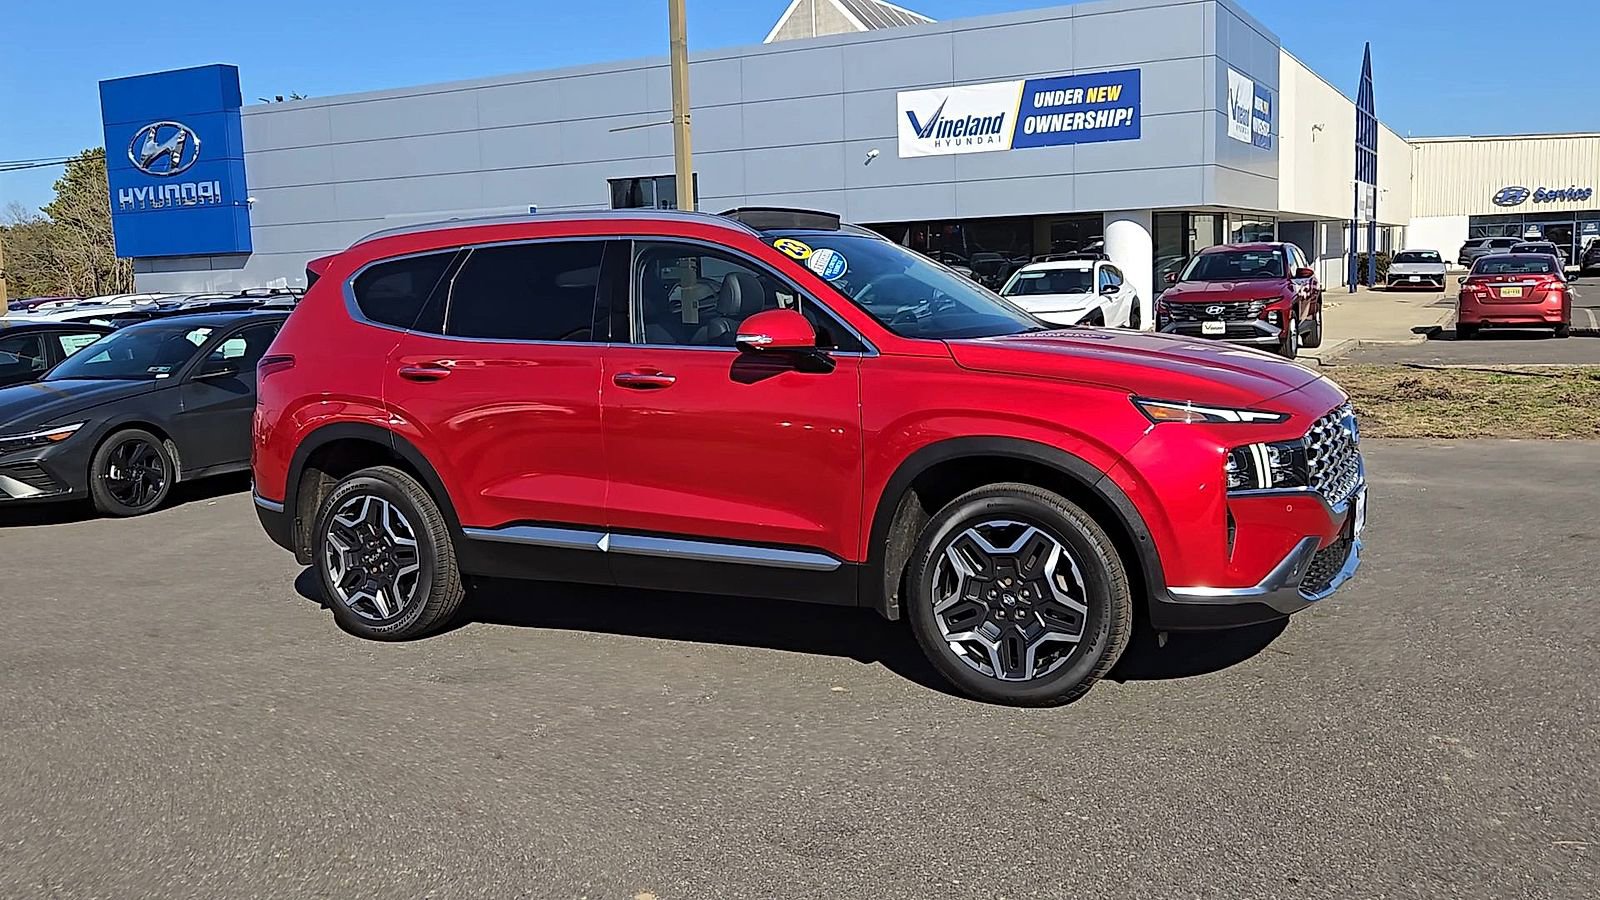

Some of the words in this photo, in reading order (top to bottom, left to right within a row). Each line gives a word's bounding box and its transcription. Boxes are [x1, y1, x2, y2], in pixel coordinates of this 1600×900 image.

[1033, 88, 1083, 108] UNDER
[1086, 85, 1122, 104] NEW
[905, 95, 1005, 139] Vineland
[1023, 107, 1134, 134] OWNERSHIP!
[934, 135, 1002, 148] HYUNDAI
[119, 181, 221, 209] HYUNDAI
[1533, 185, 1593, 203] Service
